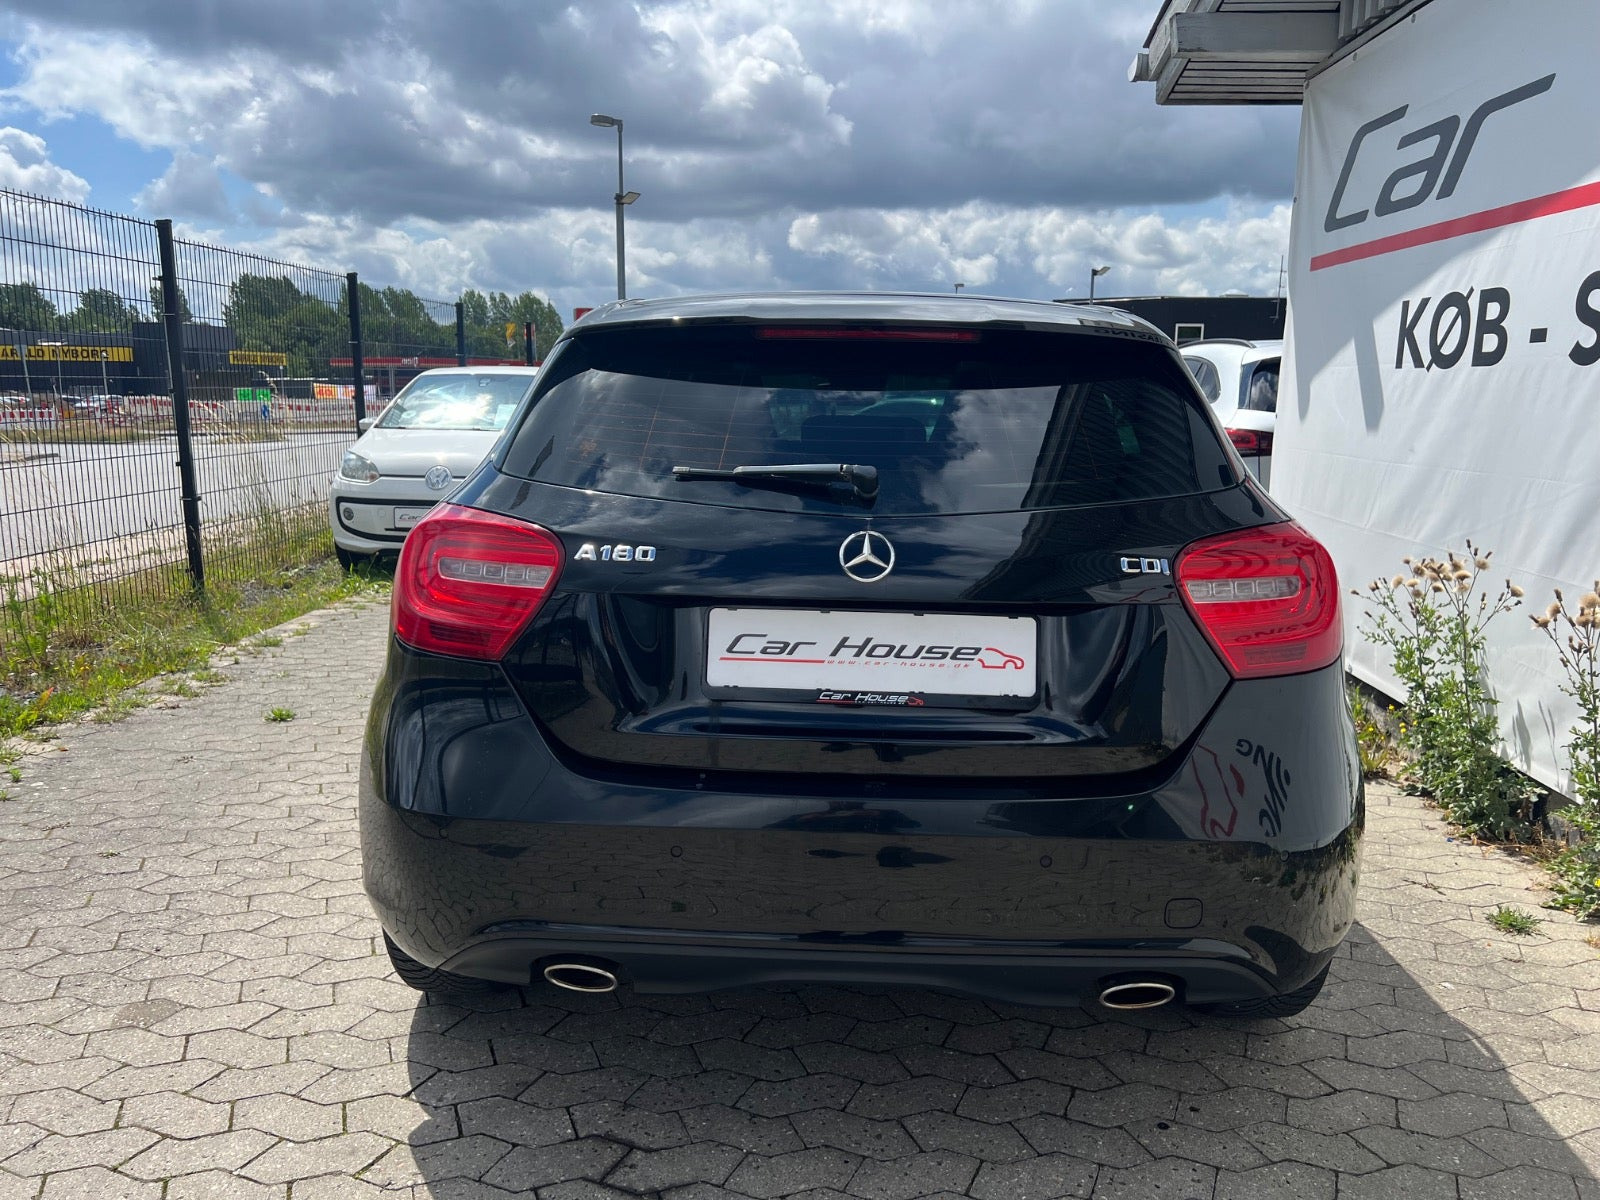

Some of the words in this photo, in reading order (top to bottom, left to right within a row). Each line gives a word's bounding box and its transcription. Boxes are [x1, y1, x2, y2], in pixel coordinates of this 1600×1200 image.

[1324, 72, 1557, 233] Car
[1395, 286, 1511, 373] KØB
[1, 348, 46, 358] ARLD
[573, 543, 657, 562] A180
[1120, 556, 1170, 576] CDI
[725, 633, 817, 656] Car
[829, 635, 983, 662] House
[827, 659, 970, 669] www.car-house.dk
[819, 691, 851, 700] Car
[855, 692, 909, 703] House
